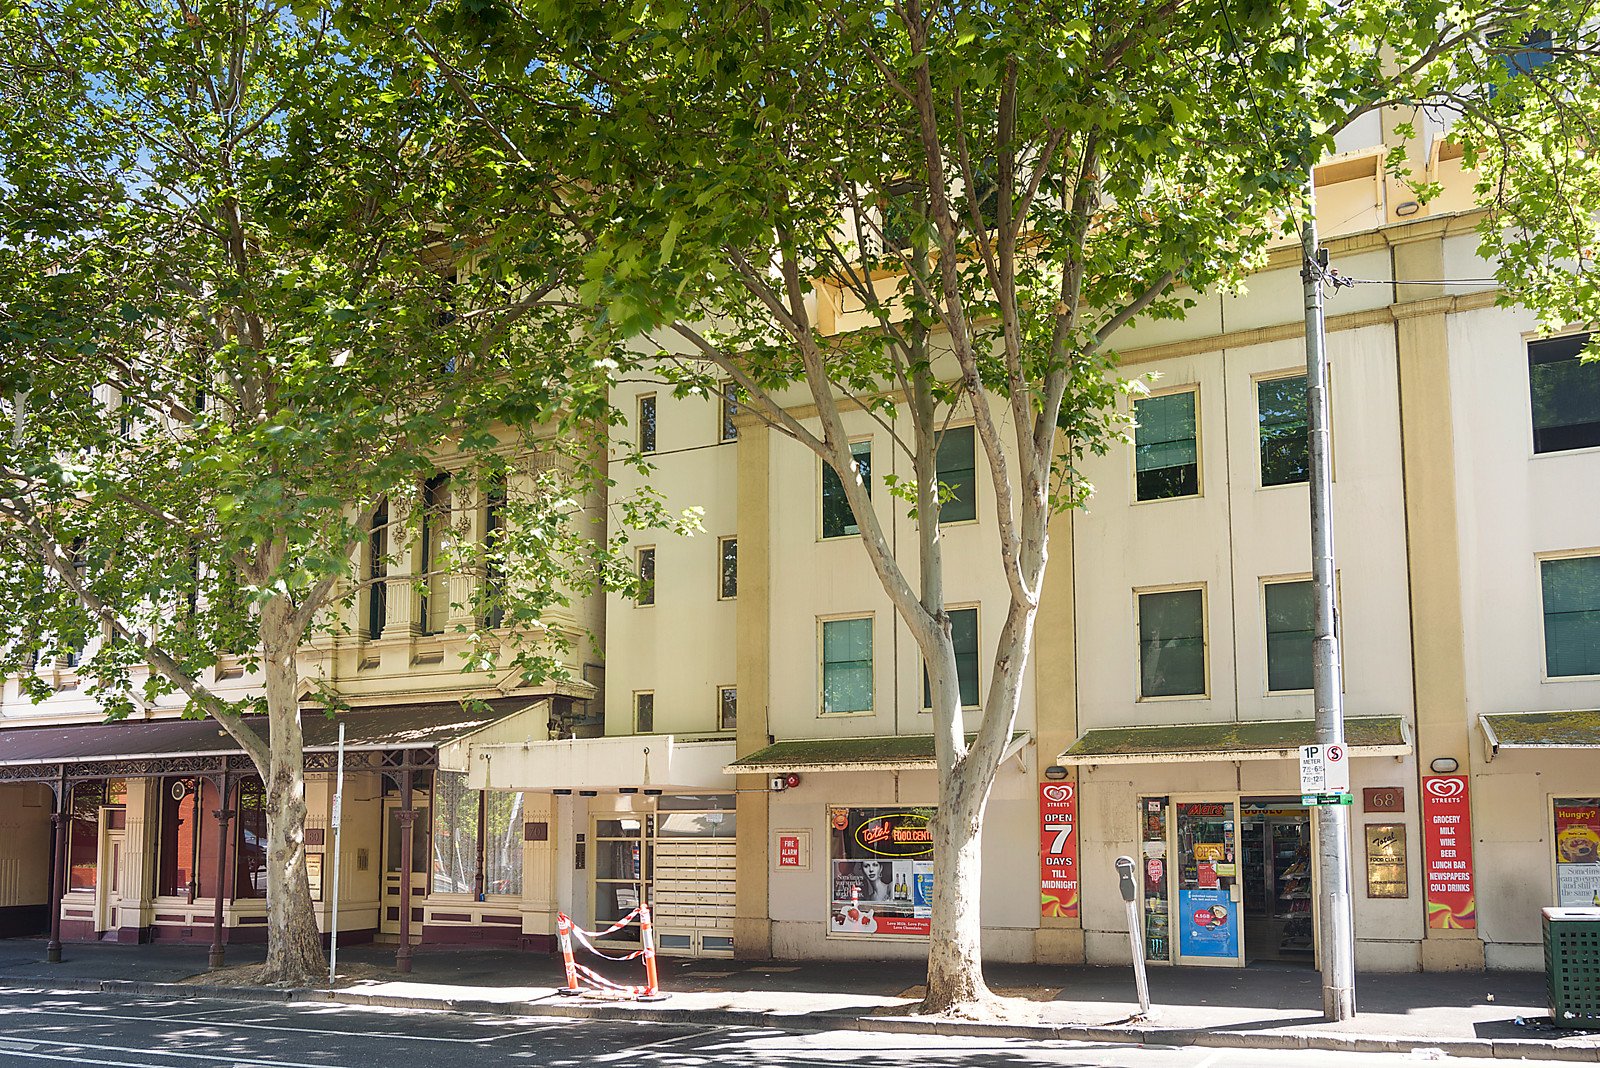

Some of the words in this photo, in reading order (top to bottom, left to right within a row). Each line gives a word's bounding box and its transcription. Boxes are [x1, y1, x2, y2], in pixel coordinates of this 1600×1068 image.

[1304, 747, 1318, 758] 1P
[1373, 794, 1394, 807] 68
[1188, 805, 1224, 815] Mars
[1559, 811, 1595, 819] Hungry?
[862, 822, 890, 842] Total
[894, 830, 911, 840] FOOD
[1045, 824, 1072, 854] 7
[1373, 832, 1395, 847] Total
[1046, 857, 1072, 865] DAYS
[918, 875, 923, 883] 3
[1052, 870, 1067, 878] TILL
[1042, 881, 1077, 889] MIDNIGHT
